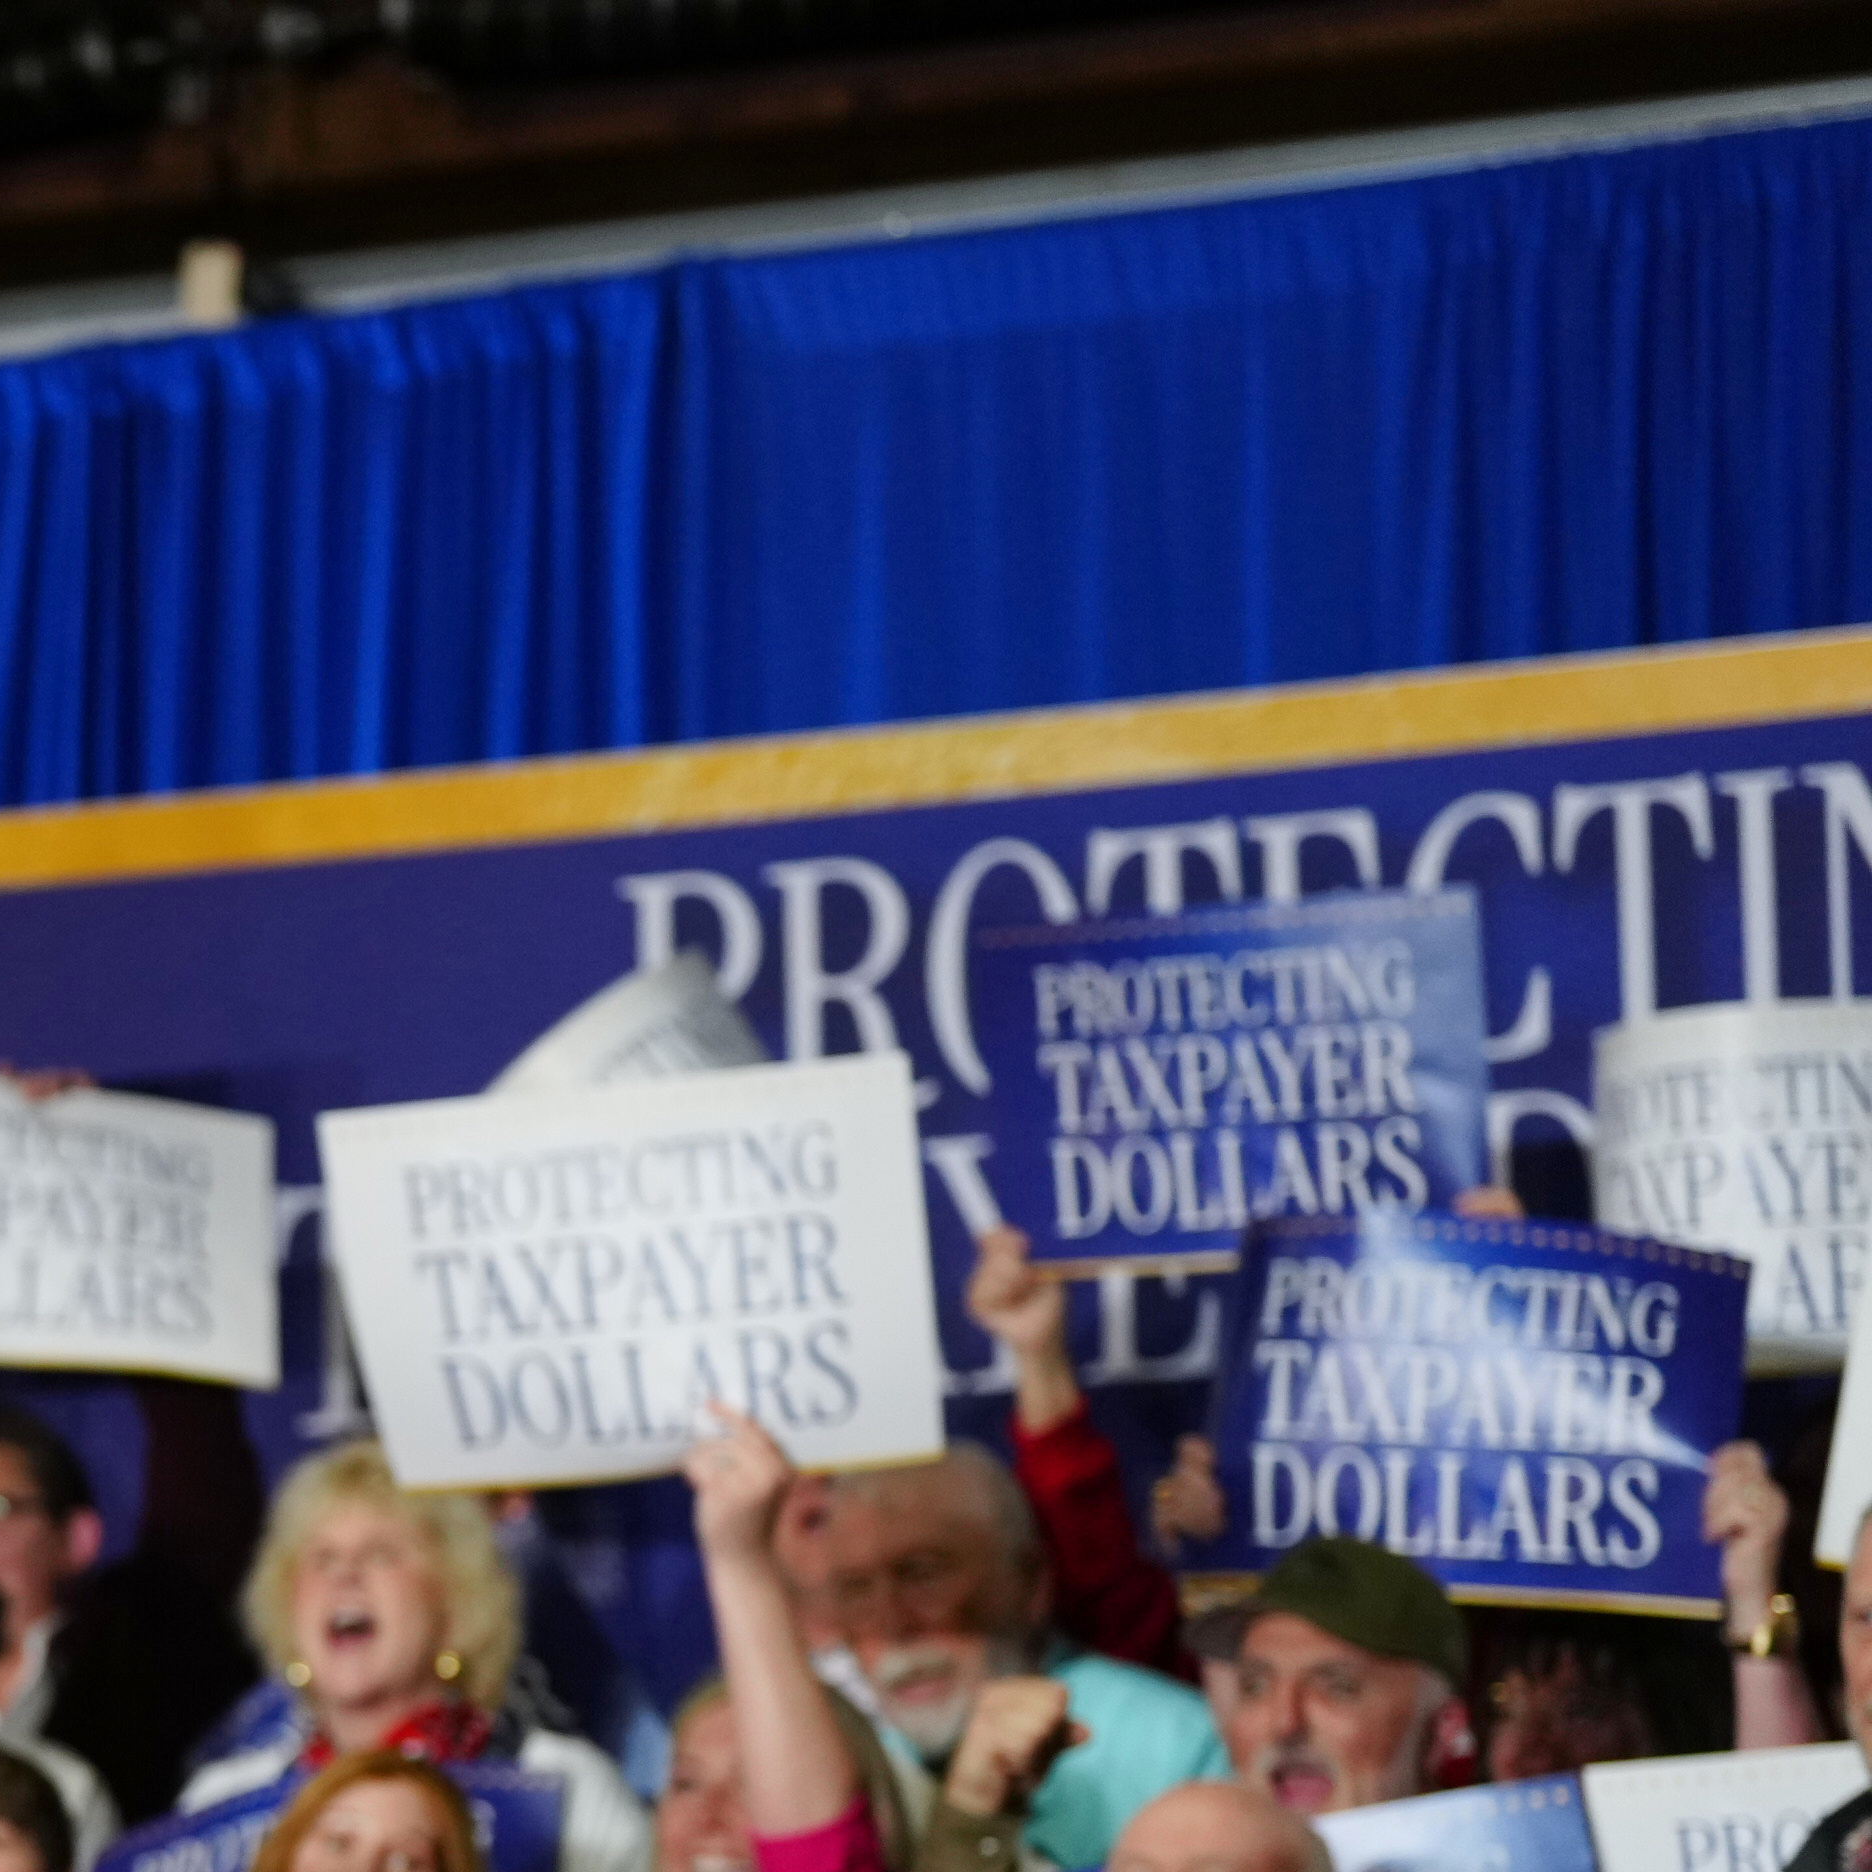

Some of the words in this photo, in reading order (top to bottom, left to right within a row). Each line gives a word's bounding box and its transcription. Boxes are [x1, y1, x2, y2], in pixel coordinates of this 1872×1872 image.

[1033, 938, 1415, 1038] PROTECTING
[1036, 1019, 1419, 1135] TAXPAYER
[400, 1118, 839, 1243] PROTECTING
[1048, 1114, 1430, 1240] DOLLARS
[413, 1210, 850, 1346] TAXPAYER
[1260, 1256, 1682, 1360] PROTECTING
[438, 1317, 860, 1453] DOLLARS
[1253, 1338, 1667, 1458] TAXPAYER
[1250, 1440, 1664, 1571] DOLLARS
